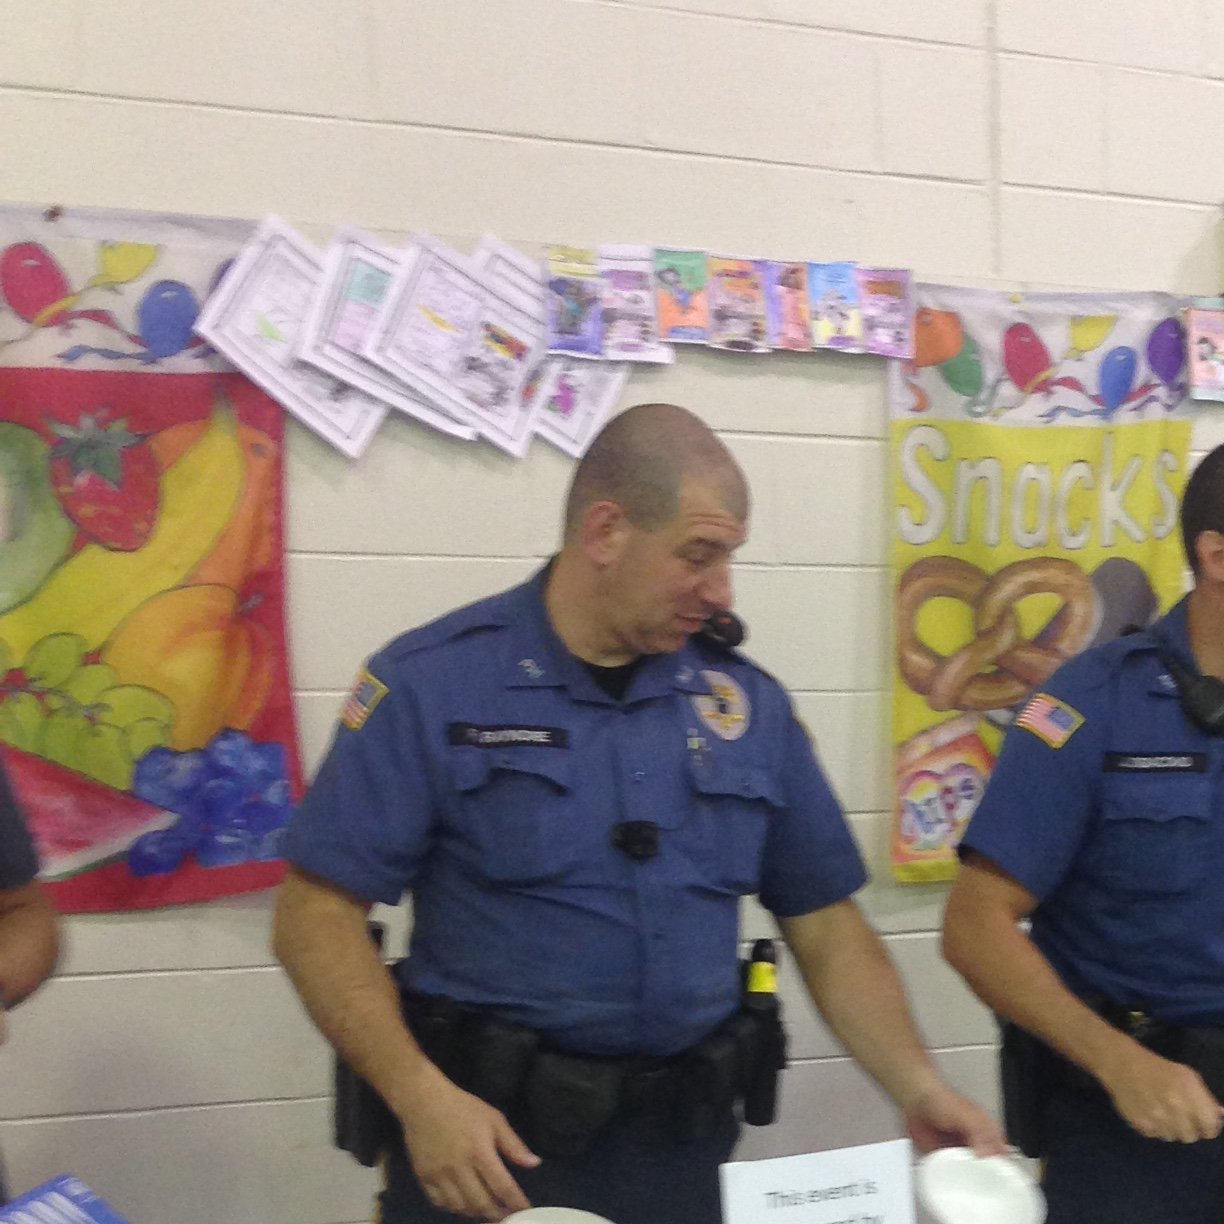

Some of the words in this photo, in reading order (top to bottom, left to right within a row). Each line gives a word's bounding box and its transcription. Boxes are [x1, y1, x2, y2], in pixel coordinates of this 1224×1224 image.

[898, 424, 1178, 550] Snacks
[762, 1187, 803, 1210] This
[808, 1182, 861, 1204] event
